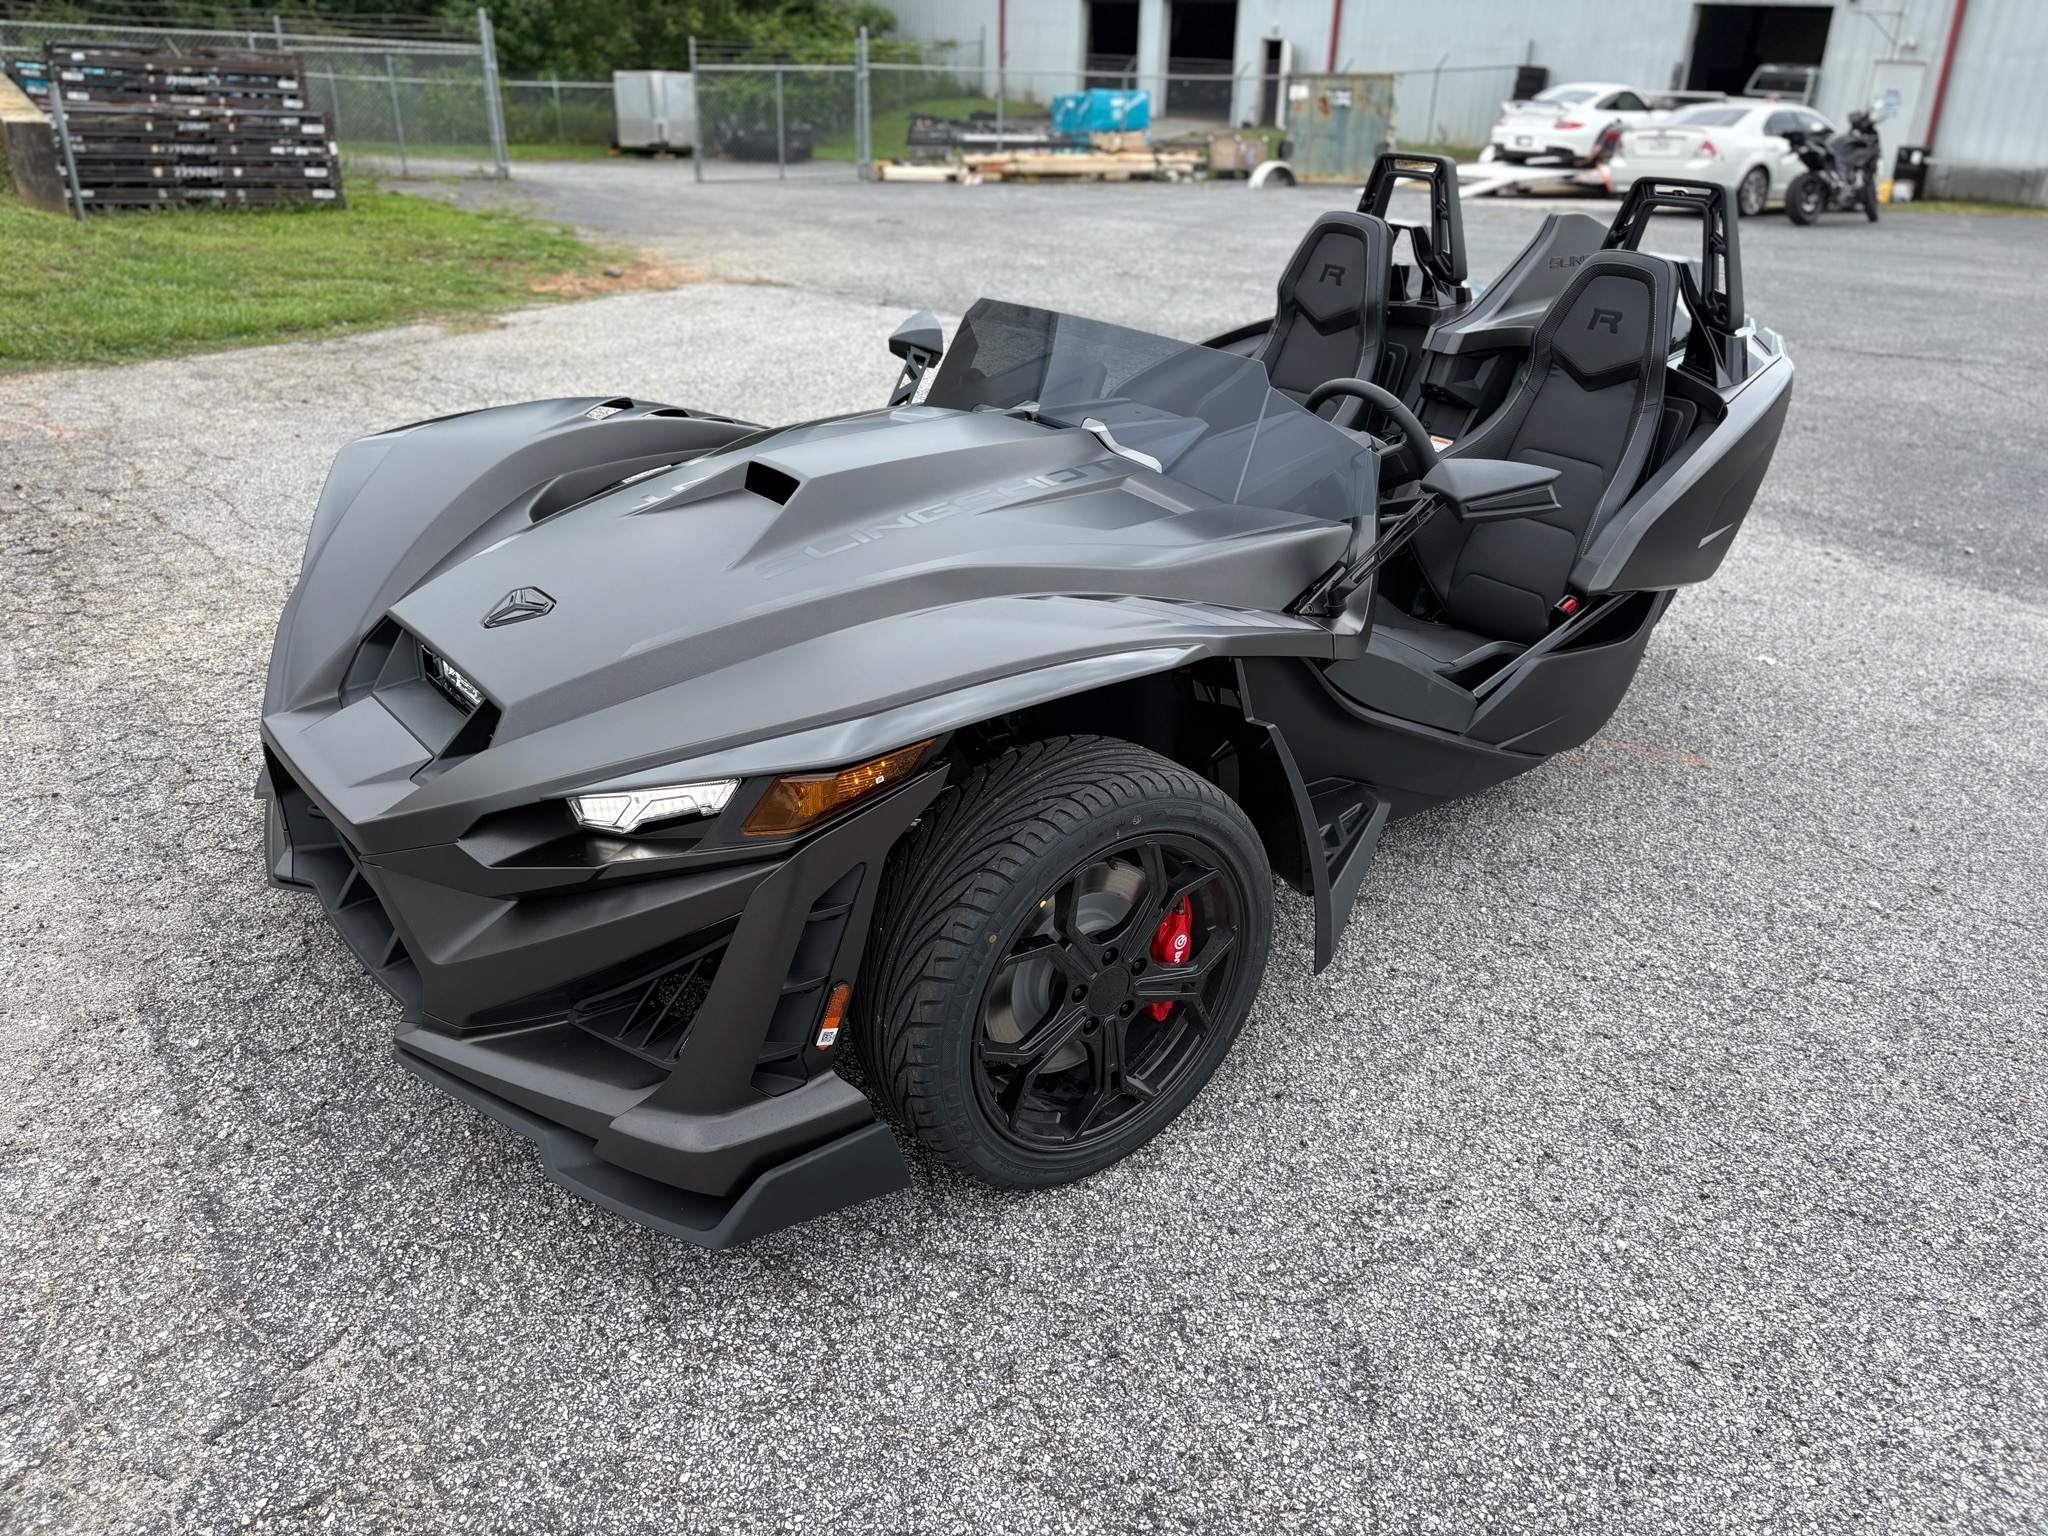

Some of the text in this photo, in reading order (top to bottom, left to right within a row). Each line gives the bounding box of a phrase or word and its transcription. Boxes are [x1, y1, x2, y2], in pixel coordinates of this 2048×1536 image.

[1319, 264, 1345, 287] R
[1586, 307, 1623, 335] R
[753, 458, 1116, 580] SLINGSHOT
